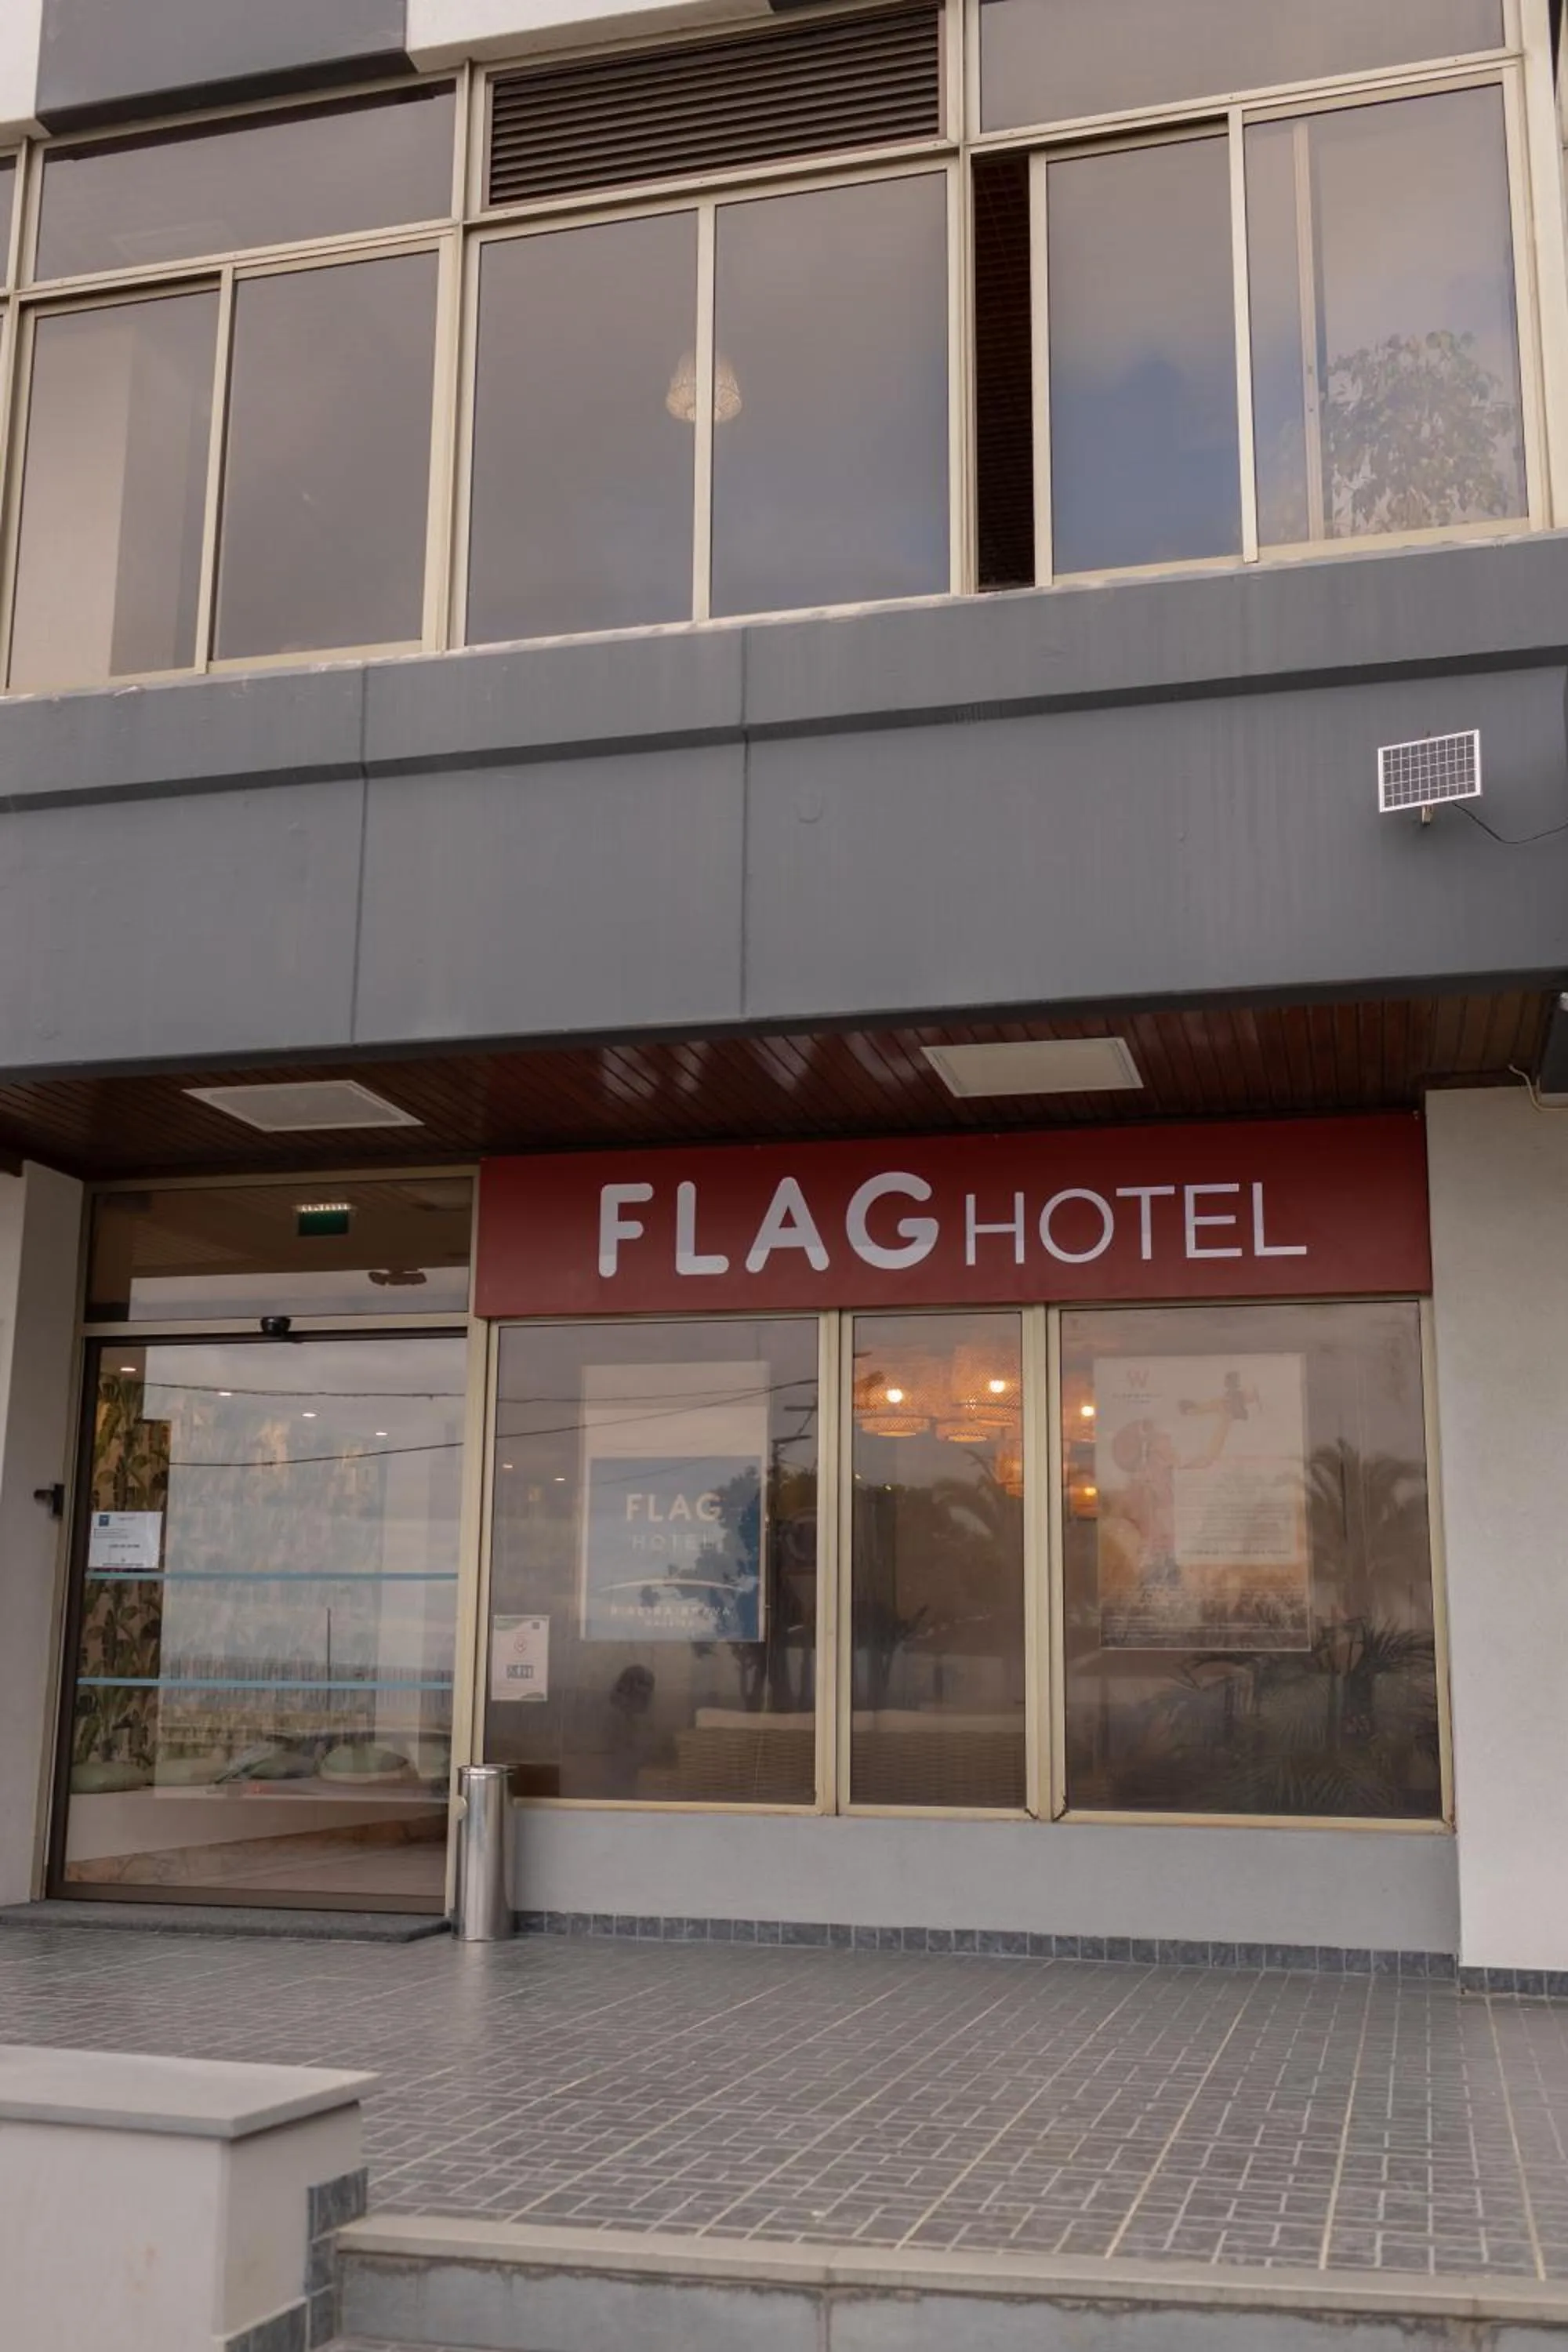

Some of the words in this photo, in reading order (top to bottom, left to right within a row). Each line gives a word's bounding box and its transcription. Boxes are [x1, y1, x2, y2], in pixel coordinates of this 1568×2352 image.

[598, 1171, 939, 1278] FLAG
[965, 1181, 1307, 1265] HOTEL
[626, 1492, 722, 1521] FLAG
[632, 1534, 714, 1551] HOTEL
